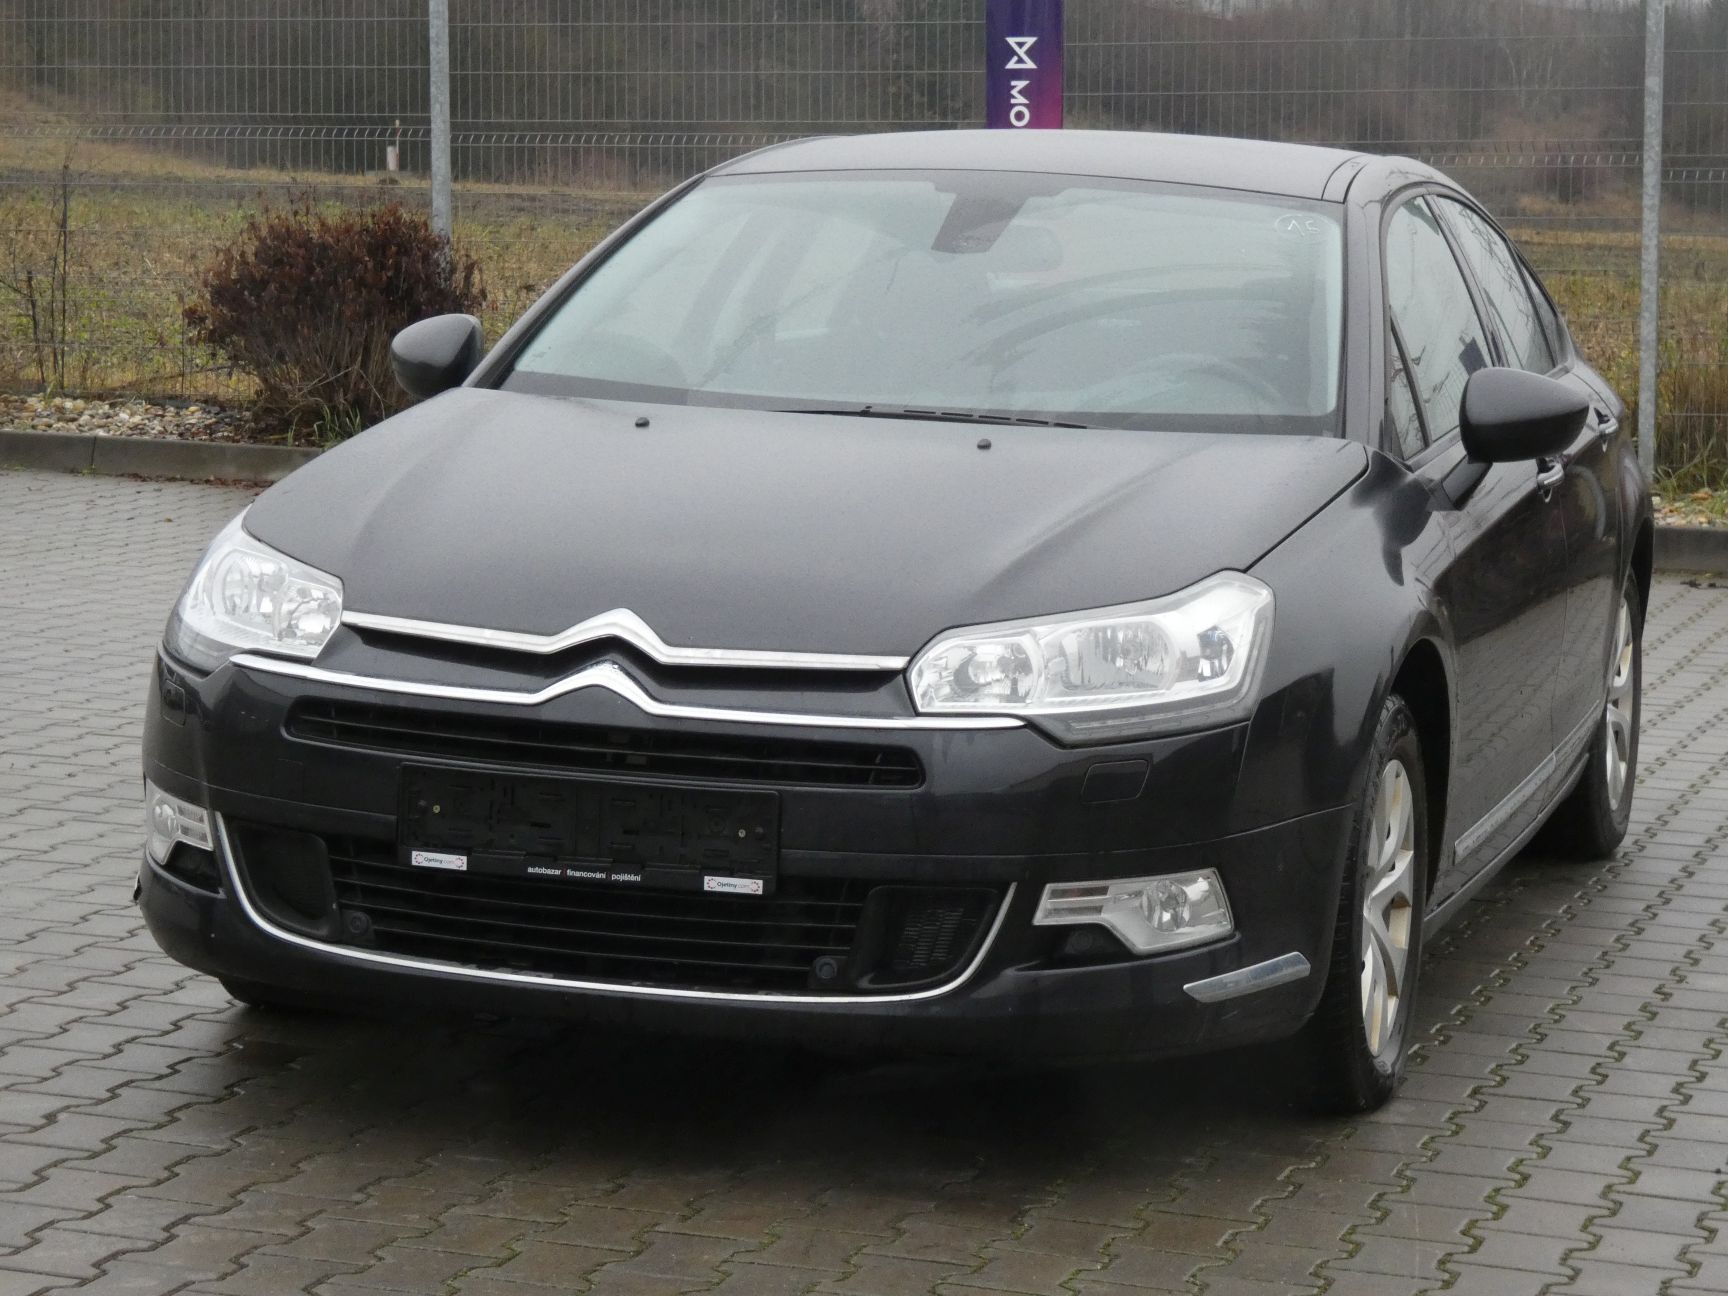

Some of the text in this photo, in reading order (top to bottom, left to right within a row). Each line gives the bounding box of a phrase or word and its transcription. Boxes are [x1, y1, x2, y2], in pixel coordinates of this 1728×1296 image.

[527, 866, 641, 882] autobazar financování pojištění
